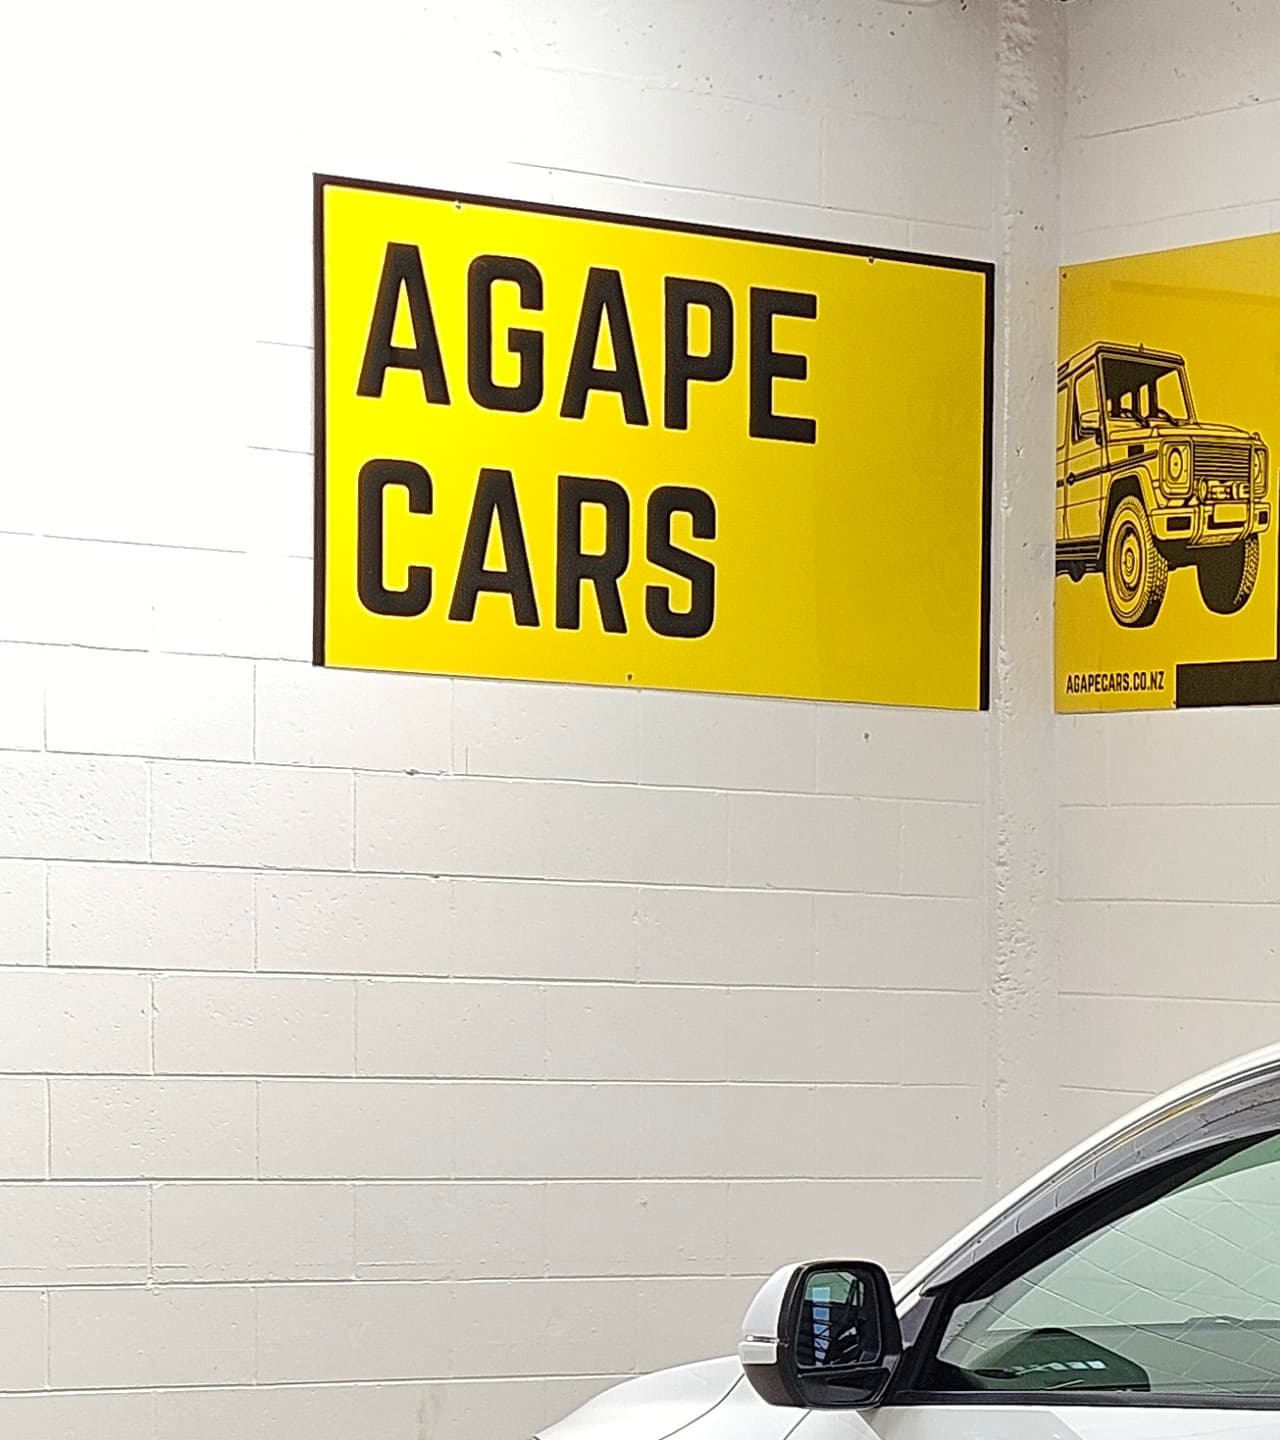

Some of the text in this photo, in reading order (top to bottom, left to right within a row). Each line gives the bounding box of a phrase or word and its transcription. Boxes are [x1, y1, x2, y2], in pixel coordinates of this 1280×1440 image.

[355, 240, 819, 446] AGAPE
[355, 456, 718, 640] CARS
[1065, 670, 1165, 694] AGAPECARS.CO.NZ
